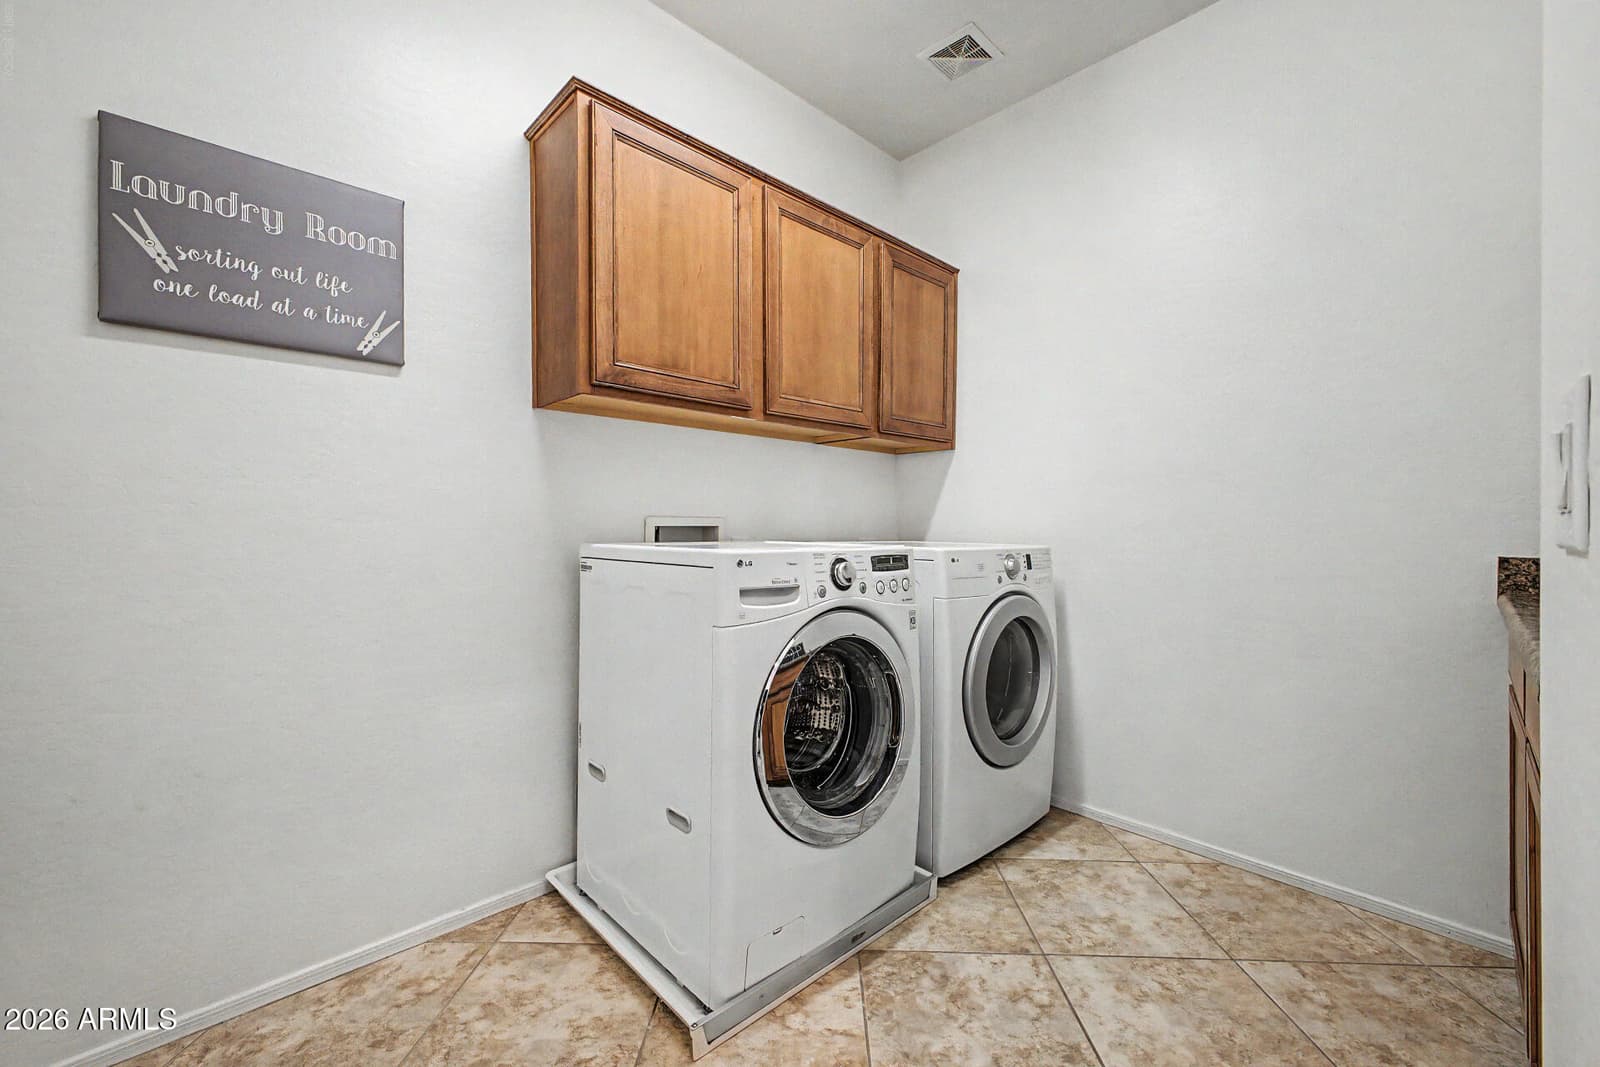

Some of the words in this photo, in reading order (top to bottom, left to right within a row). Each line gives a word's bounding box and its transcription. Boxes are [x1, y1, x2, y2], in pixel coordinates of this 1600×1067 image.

[109, 159, 284, 235] Laundry
[305, 211, 398, 260] Room
[175, 244, 263, 280] sorting
[272, 266, 310, 285] out
[316, 271, 353, 297] life
[153, 279, 199, 297] one
[209, 285, 263, 310] load
[272, 297, 295, 316] at
[303, 305, 318, 320] a
[325, 305, 369, 329] time
